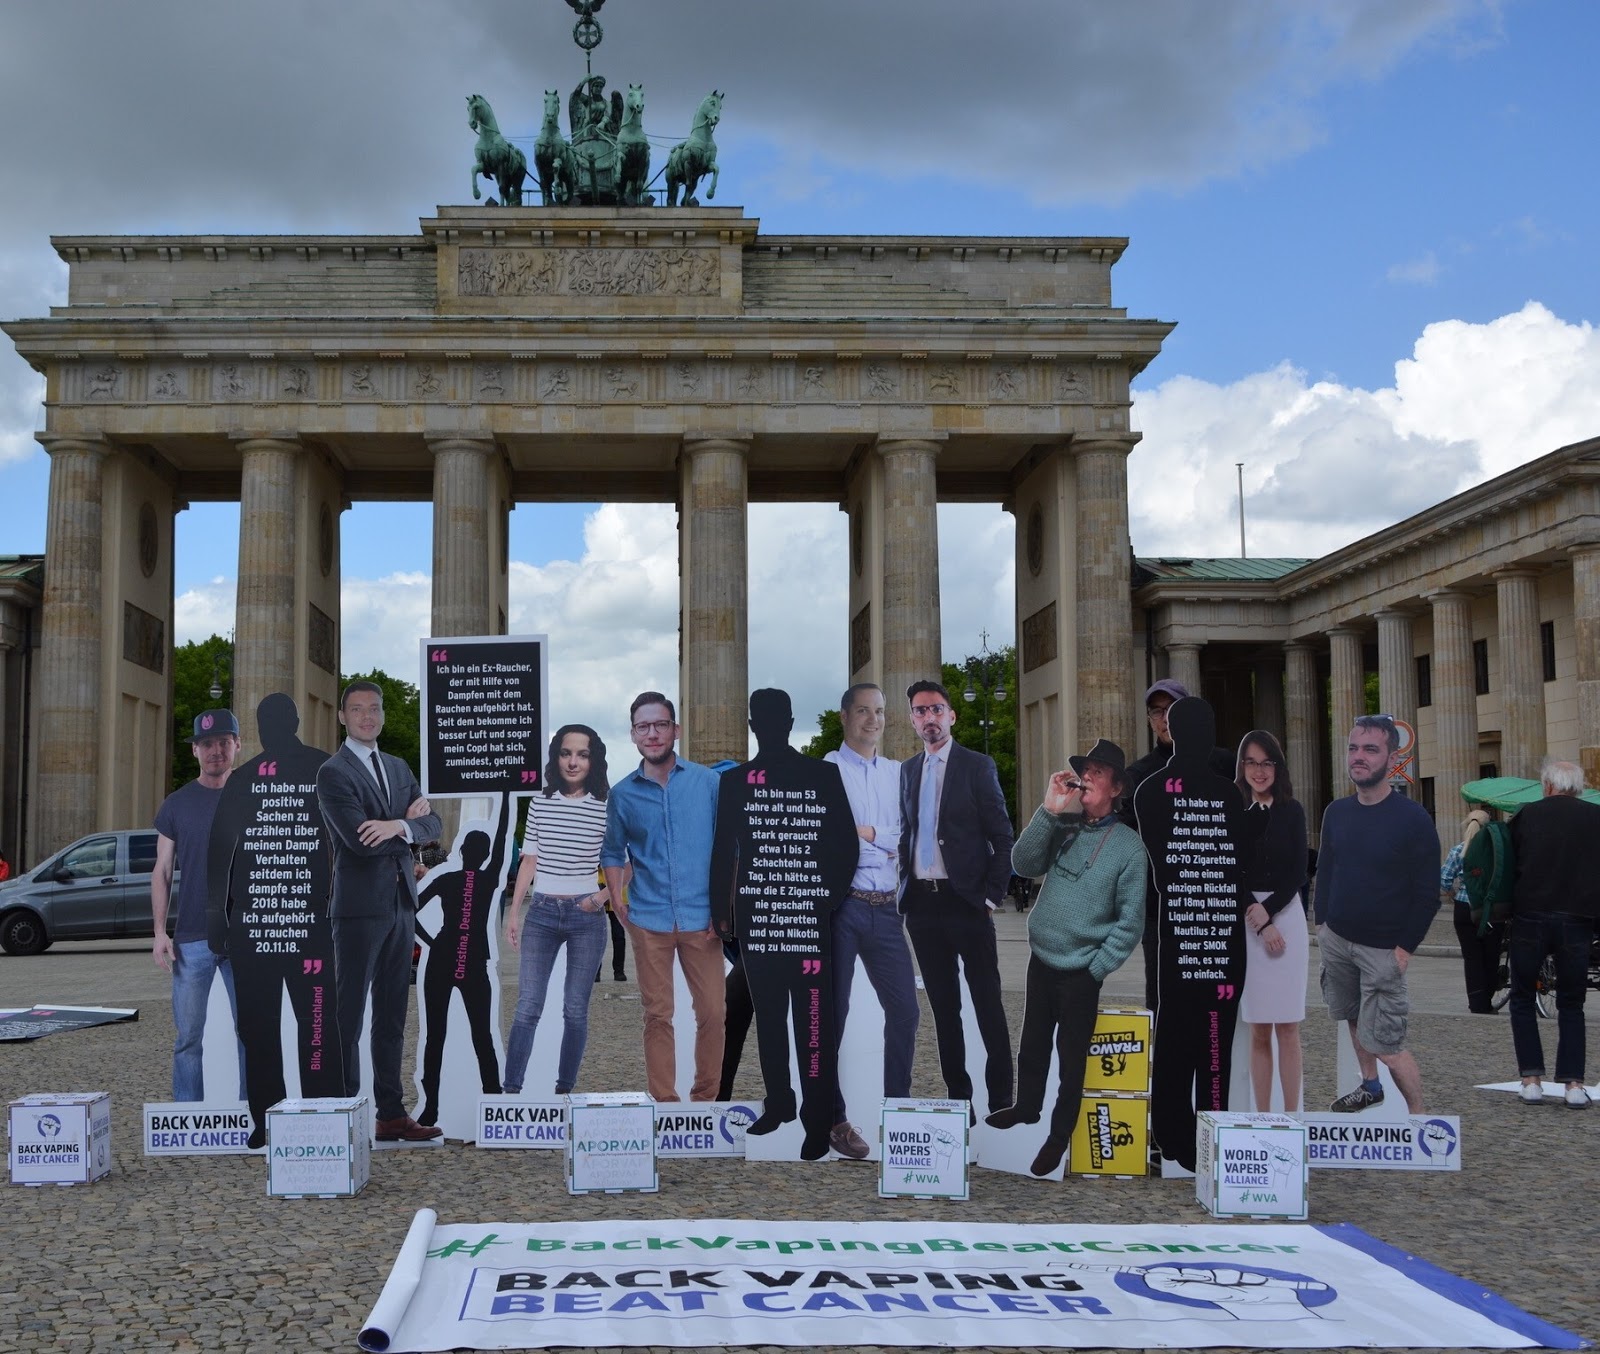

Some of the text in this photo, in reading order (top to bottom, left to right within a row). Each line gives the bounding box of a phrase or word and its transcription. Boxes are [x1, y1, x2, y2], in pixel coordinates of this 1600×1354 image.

[437, 663, 532, 674] Ich bin ein Ex-Raucher,
[450, 678, 463, 686] der
[466, 677, 480, 686] mit
[483, 677, 502, 685] Hilfe
[448, 690, 521, 701] Dampfen mit dem
[436, 702, 534, 714] Rauchen aufgehört hat.
[438, 716, 532, 726] Seit dem bekomme ich
[469, 730, 487, 739] Luft
[489, 730, 505, 738] und
[507, 731, 531, 739] sogar
[444, 742, 526, 753] mein Copd hat sich,
[446, 756, 525, 767] zumindest, gefühlt
[461, 770, 510, 779] verbessert.
[252, 782, 317, 793] Ich habe nur
[754, 789, 816, 799] Ich bin nun 53
[262, 797, 304, 809] positive
[744, 802, 826, 813] Jahre alt und habe
[1174, 798, 1187, 807] Ich
[1189, 798, 1209, 808] habe
[256, 811, 309, 821] Sachen zu
[749, 816, 762, 825] bis
[782, 817, 788, 826] 4
[790, 817, 821, 827] Jahren
[1173, 812, 1225, 822] 4 Jahren mit
[246, 825, 319, 836] erzählen über
[752, 830, 818, 841] stark geraucht
[1173, 826, 1227, 838] dem dampfen
[244, 839, 320, 852] meinen Dampf
[1167, 840, 1217, 852] angefangen,
[256, 854, 306, 865] Verhalten
[753, 857, 801, 868] Schachteln
[1166, 854, 1236, 866] 60-70 Zigaretten
[250, 868, 311, 879] seitdem ich
[748, 871, 766, 883] Tag.
[769, 872, 782, 881] Ich
[785, 872, 809, 882] hätte
[1179, 869, 1224, 878] ohne einen
[249, 883, 311, 896] dampfe seit
[740, 885, 829, 898] ohne die E Zigarette
[1167, 883, 1236, 894] einzigen Rückfall
[252, 898, 307, 908] 2018 habe
[755, 900, 814, 911] nie geschafft
[1168, 897, 1236, 909] auf 18mg Nikotin
[243, 912, 315, 925] ich aufgehört
[752, 914, 817, 925] von Zigaretten
[1169, 912, 1236, 923] Liquid mit einem
[455, 870, 475, 980] Christina, Deutschland
[249, 927, 308, 938] zu rauchen
[750, 928, 766, 937] und
[787, 929, 819, 938] Nikotin
[256, 942, 300, 952] 20.11.18.
[748, 944, 765, 953] weg
[781, 942, 820, 952] kommen.
[1180, 941, 1227, 950] einer SMOK
[1182, 969, 1226, 979] so einfach.
[311, 986, 323, 1070] Bilo, Deutschland
[808, 988, 820, 1077] Hans, Deutschland
[1208, 1011, 1219, 1072] Deutschland
[484, 1107, 526, 1123] BACK
[151, 1114, 249, 1130] BACK VAPING
[484, 1125, 522, 1140] BEAT
[889, 1132, 930, 1143] WORLD
[1098, 1106, 1112, 1158] PRAWO
[1309, 1126, 1412, 1143] BACK VAPING
[152, 1131, 250, 1147] BEAT CANCER
[1089, 1115, 1101, 1166] DLA LUDZI
[18, 1143, 79, 1154] BACK VAPING
[576, 1140, 650, 1152] APORVAP
[273, 1146, 346, 1158] APORVAP
[1224, 1149, 1268, 1161] WORLD
[1309, 1144, 1412, 1161] BEAT CANCER
[18, 1154, 80, 1164] BEAT CANCER
[888, 1157, 931, 1166] ALLIANCE
[1224, 1175, 1269, 1185] ALLIANCE
[496, 1268, 1085, 1292] BACK VAPING
[490, 1291, 1113, 1316] BEAT CANCER
